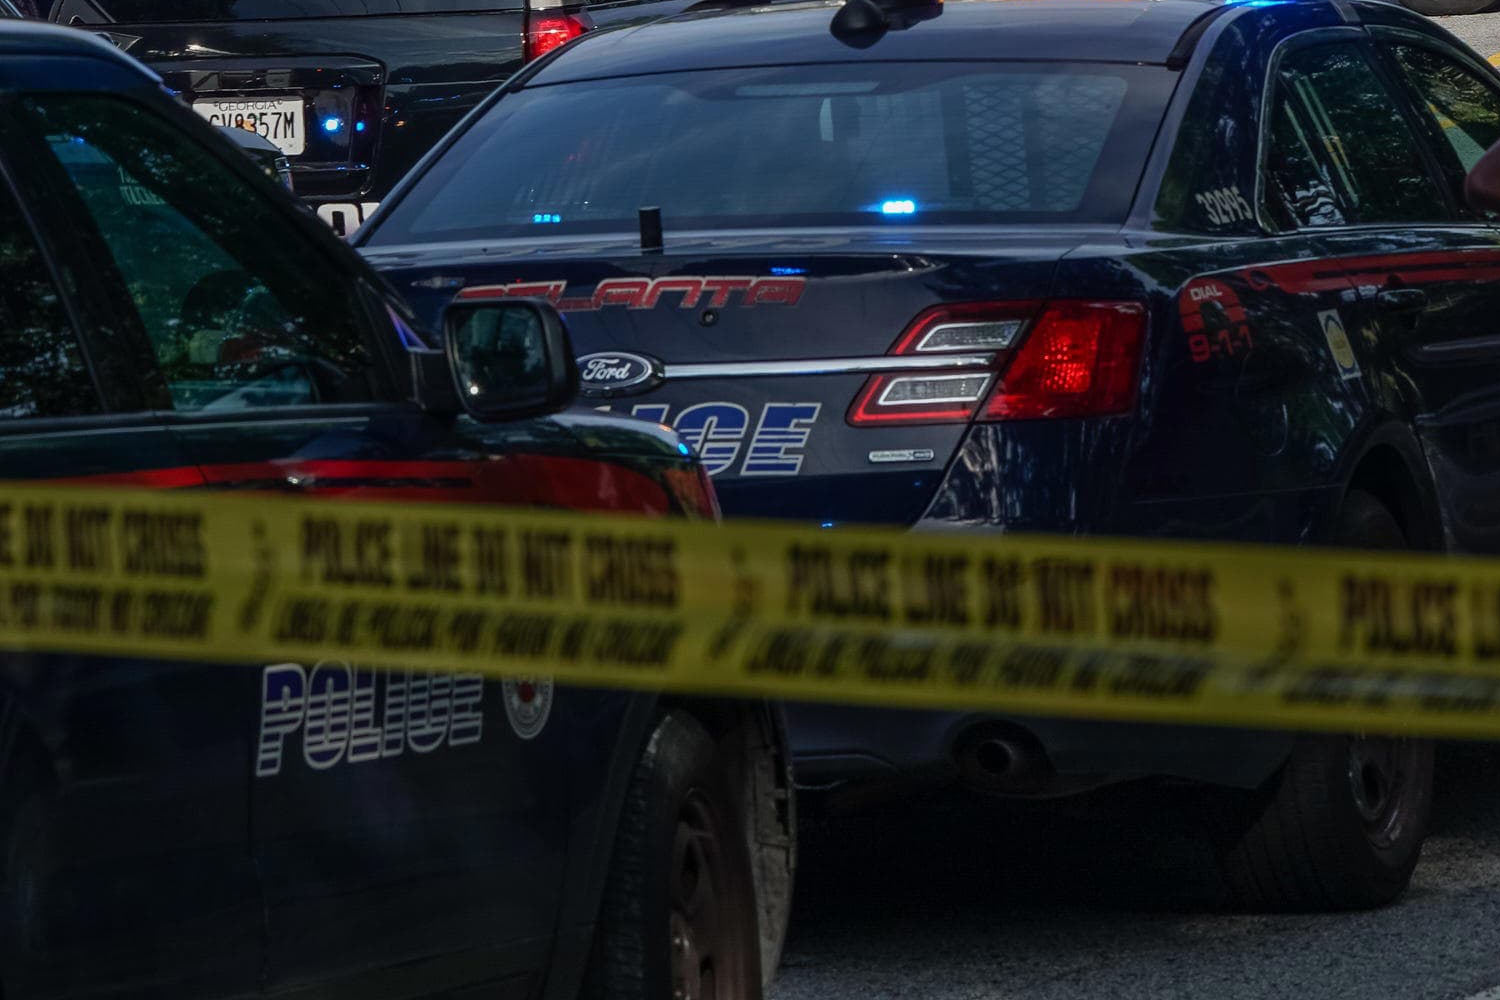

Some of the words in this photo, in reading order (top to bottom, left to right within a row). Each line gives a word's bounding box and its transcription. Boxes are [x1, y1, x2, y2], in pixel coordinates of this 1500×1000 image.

[218, 101, 277, 112] GEORGIA
[1190, 284, 1223, 300] DIAL
[582, 357, 632, 382] Ford
[1188, 324, 1254, 362] 9-1-1
[301, 517, 394, 584] POLICE
[518, 529, 573, 599] NOT
[787, 543, 894, 619] POLICE
[1034, 557, 1095, 633] NOT
[1340, 575, 1458, 655] POLICE
[256, 660, 484, 778] POLICE
